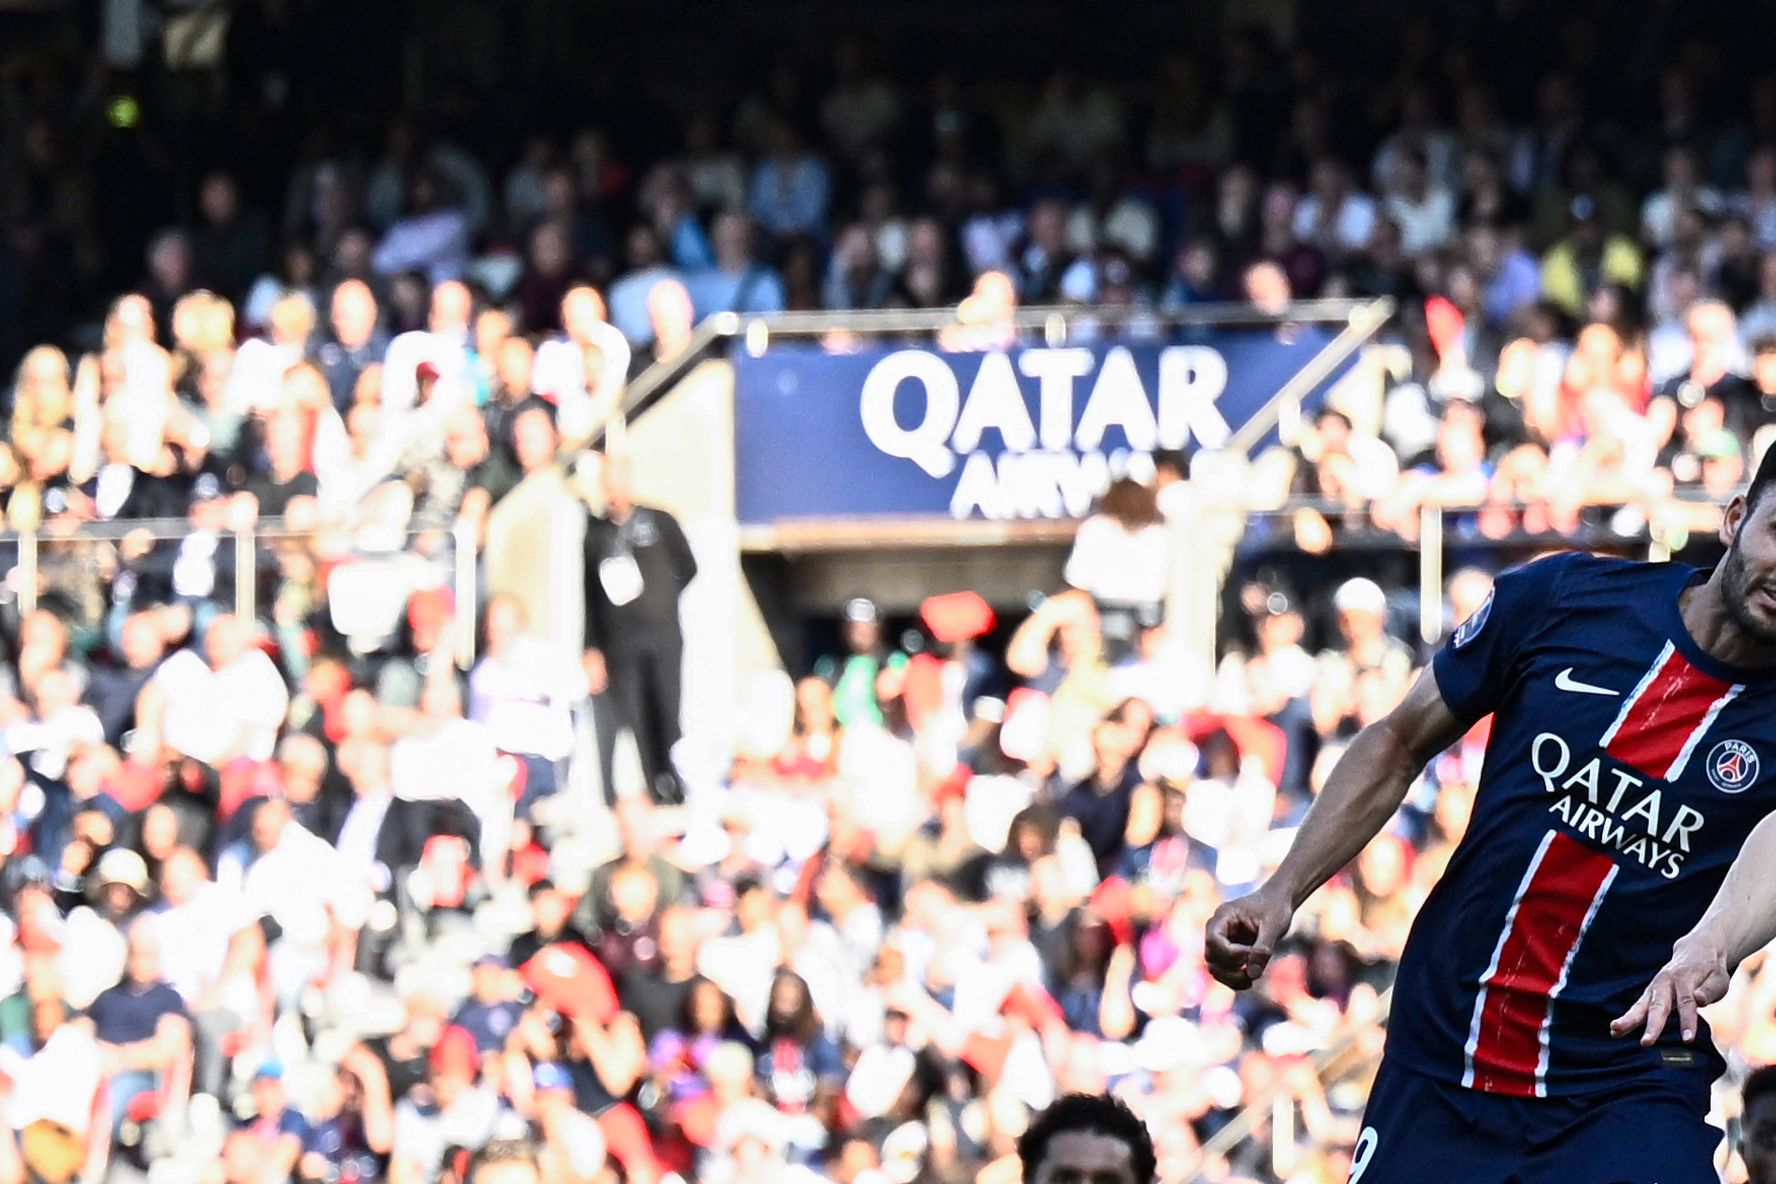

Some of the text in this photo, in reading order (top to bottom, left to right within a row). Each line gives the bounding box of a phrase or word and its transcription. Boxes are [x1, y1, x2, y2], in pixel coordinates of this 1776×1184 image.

[860, 346, 1232, 478] QATAR
[1531, 732, 1704, 852] QATAR
[1724, 741, 1756, 763] PARIS
[1548, 795, 1685, 879] AIRWAYS
